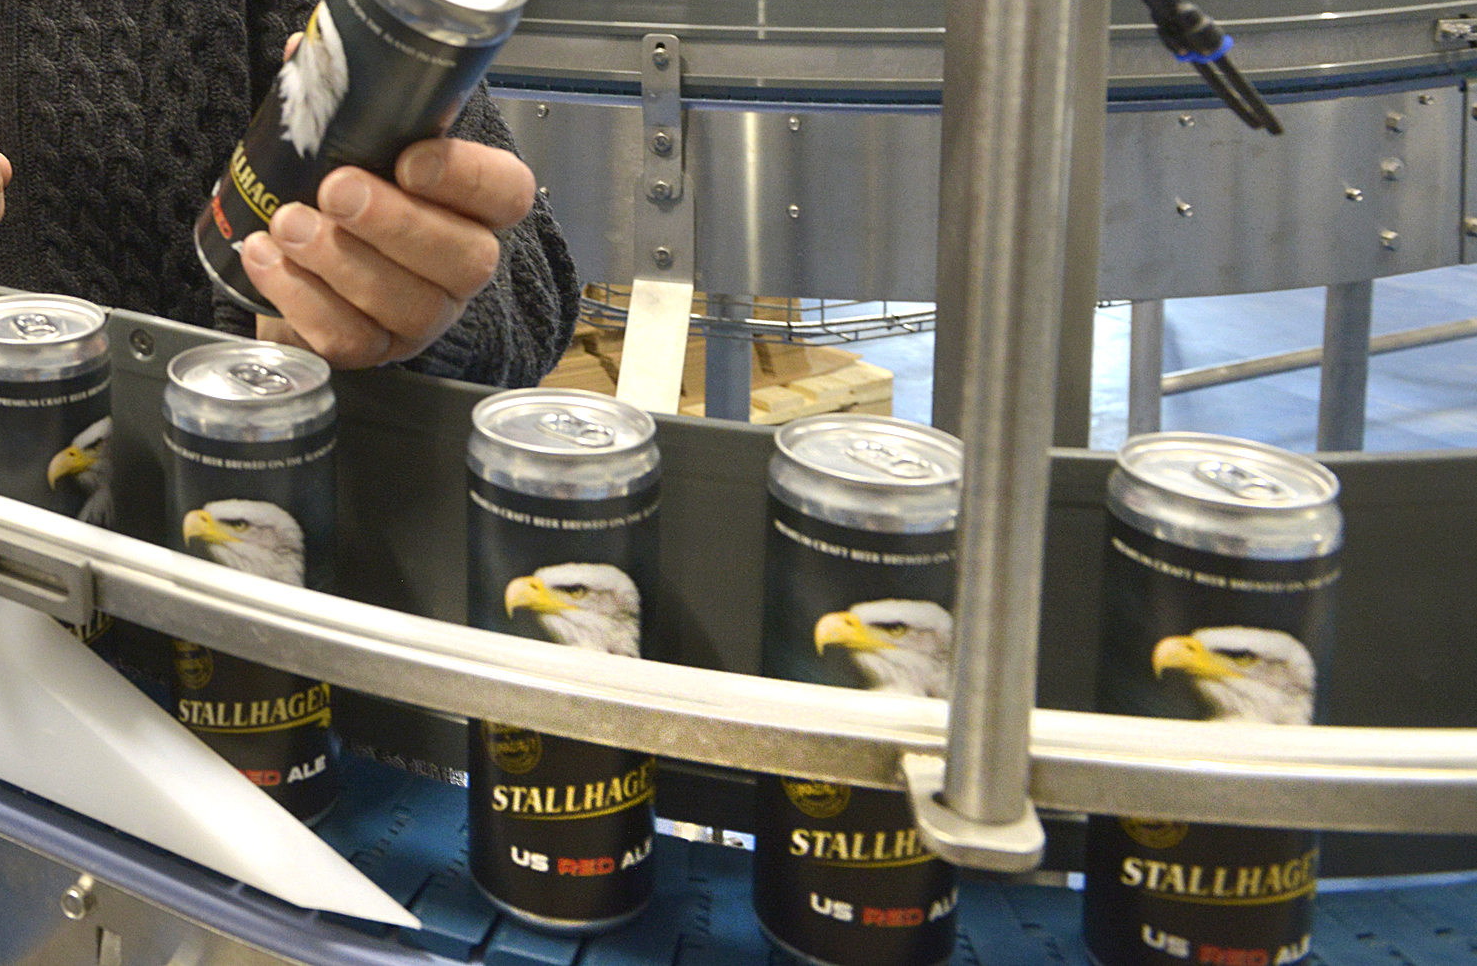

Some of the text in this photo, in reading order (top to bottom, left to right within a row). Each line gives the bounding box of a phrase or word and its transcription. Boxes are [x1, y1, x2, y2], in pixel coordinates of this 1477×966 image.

[286, 753, 327, 784] ALE
[510, 844, 550, 873] US
[556, 855, 616, 877] RED
[809, 890, 854, 923] US
[861, 906, 925, 927] RED
[1140, 922, 1191, 959] US
[1197, 943, 1269, 966] RED
